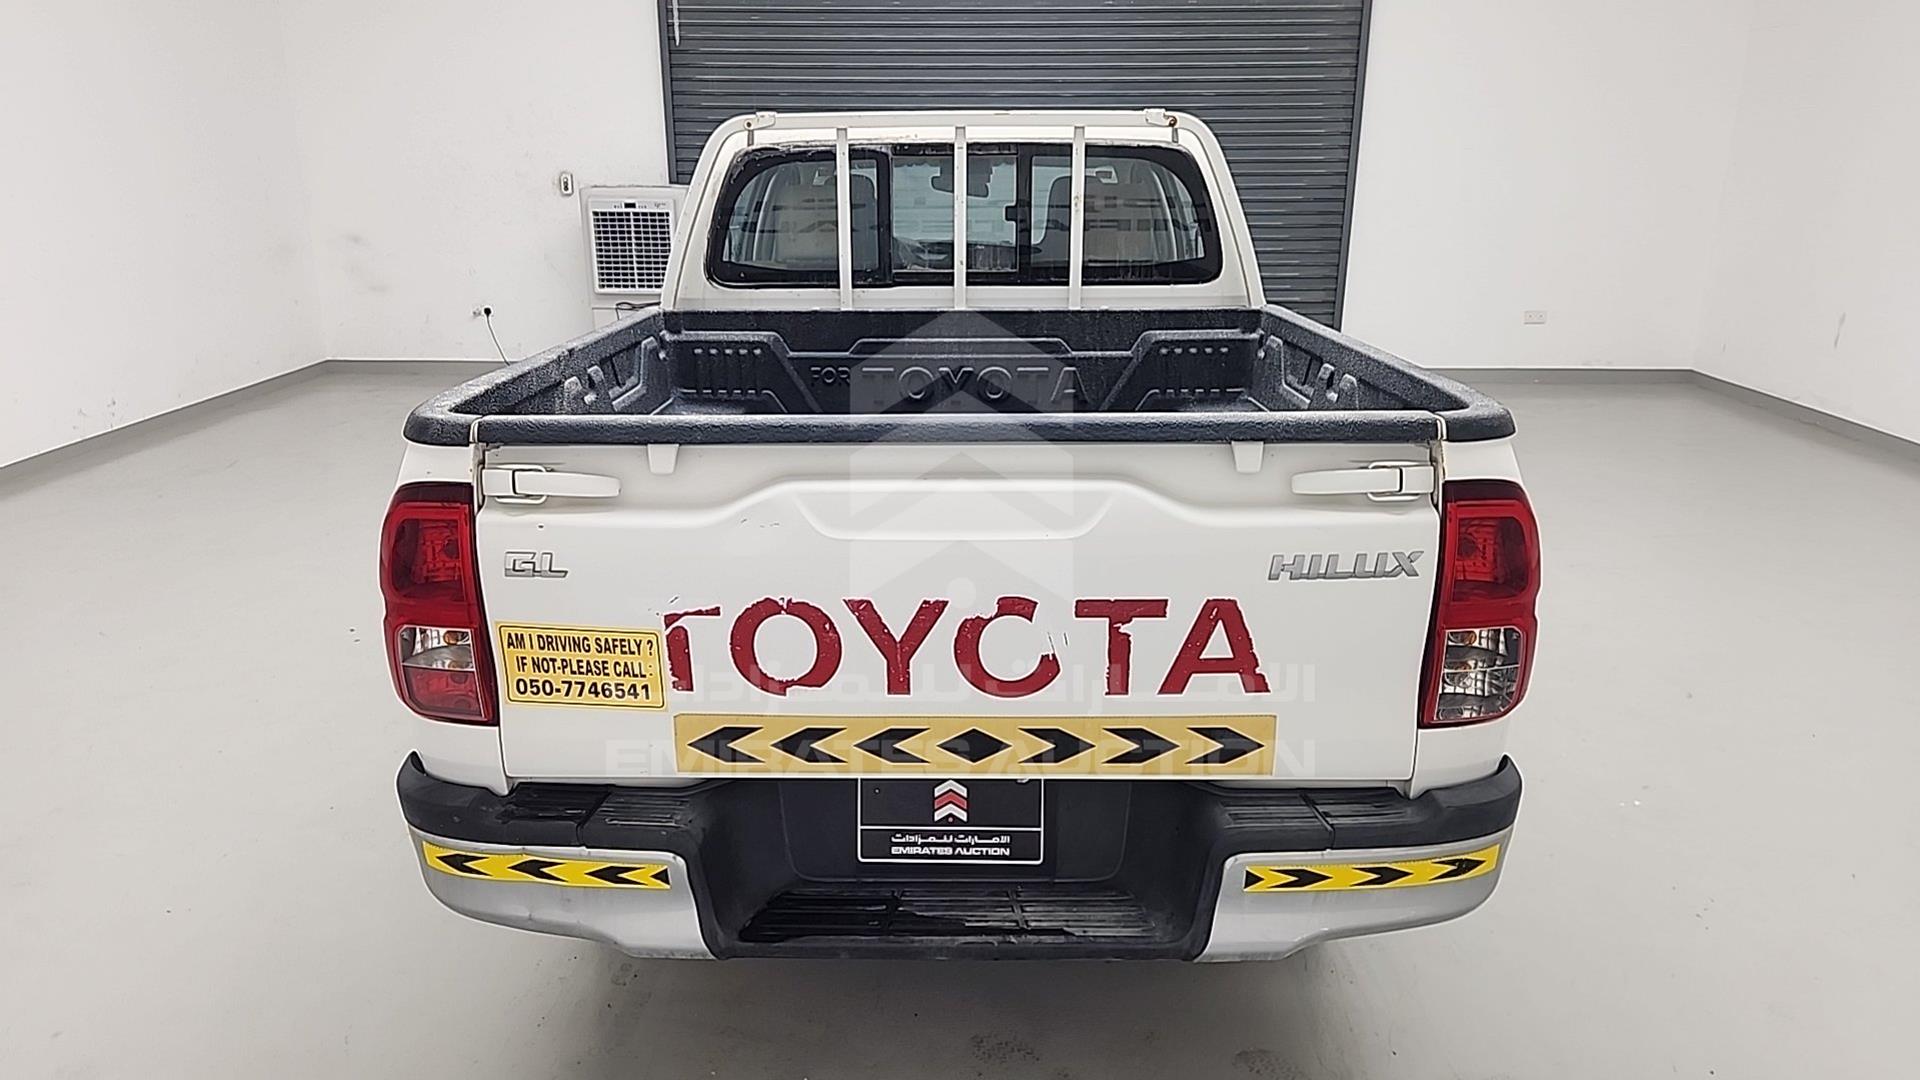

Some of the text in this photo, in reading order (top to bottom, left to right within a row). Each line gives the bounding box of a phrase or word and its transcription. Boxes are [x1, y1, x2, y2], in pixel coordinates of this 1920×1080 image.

[810, 365, 1091, 404] FOR TOYOTA
[504, 550, 569, 578] GL
[1268, 550, 1425, 581] HILUX
[507, 633, 654, 657] AM I DRIVING SAFELY ?
[663, 596, 1272, 698] TOYOTA
[516, 656, 527, 673] IF
[531, 657, 610, 677] NOT-PLEASE
[516, 678, 651, 700] 050-7746541
[891, 846, 1010, 856] EMIRATES AUCTION
